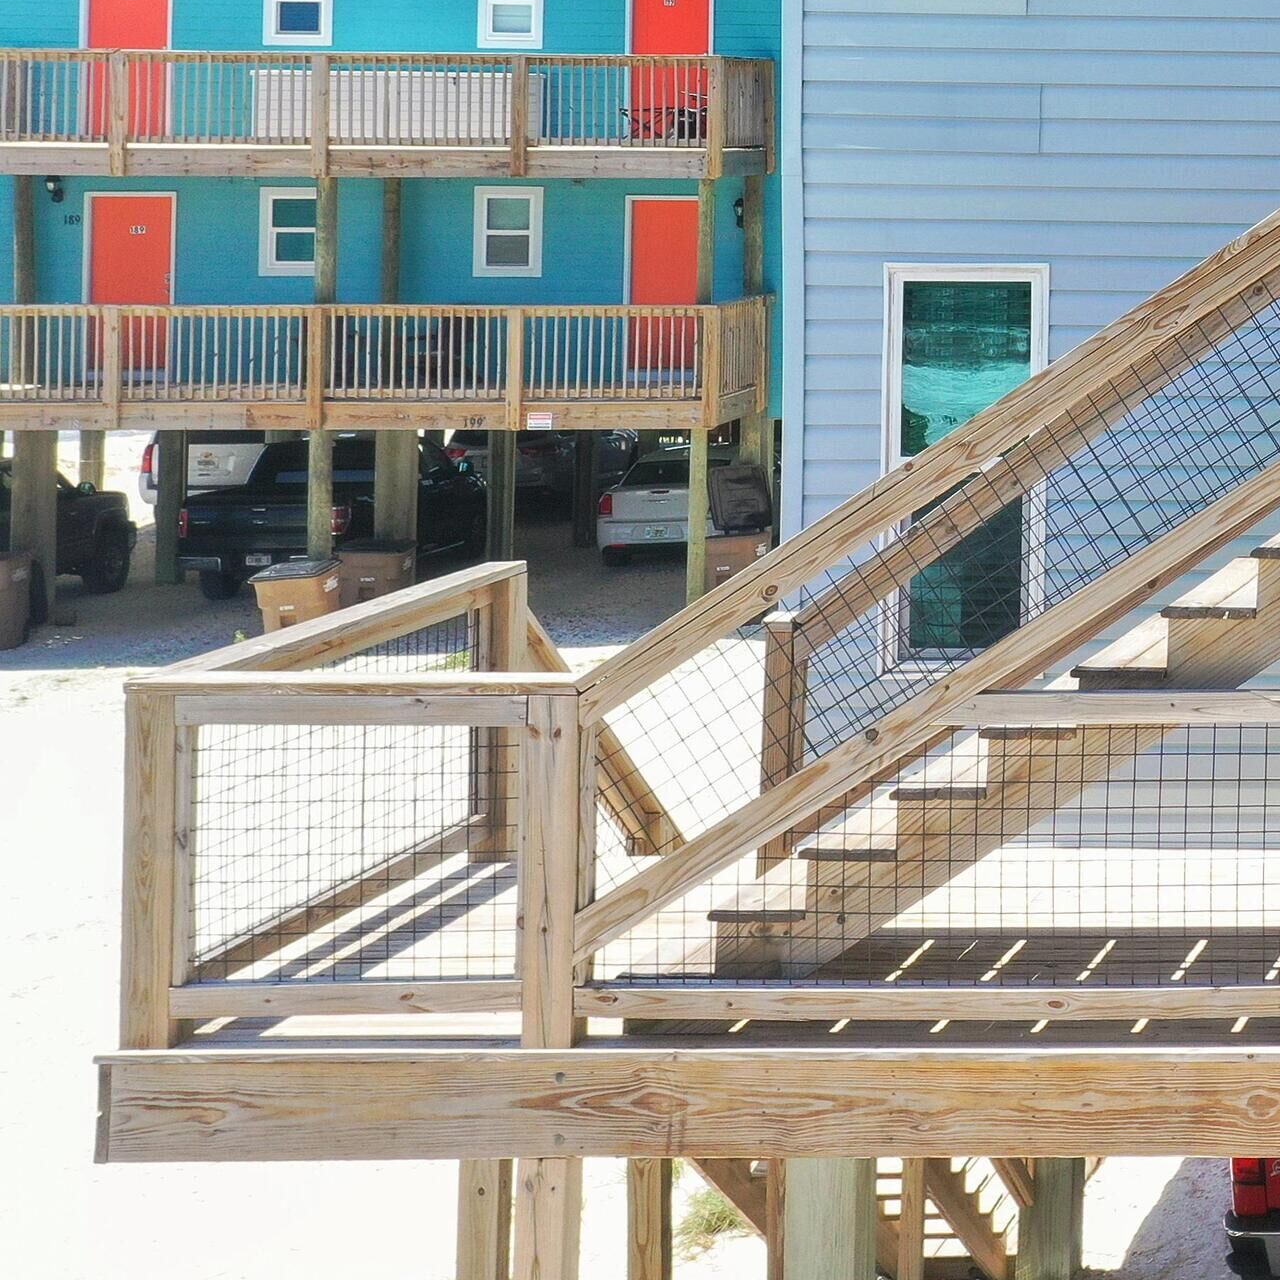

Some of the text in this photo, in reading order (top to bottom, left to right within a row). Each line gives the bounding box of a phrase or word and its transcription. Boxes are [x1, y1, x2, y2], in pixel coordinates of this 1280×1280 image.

[63, 214, 80, 225] 189
[130, 225, 145, 234] 189
[463, 416, 485, 428] 199
